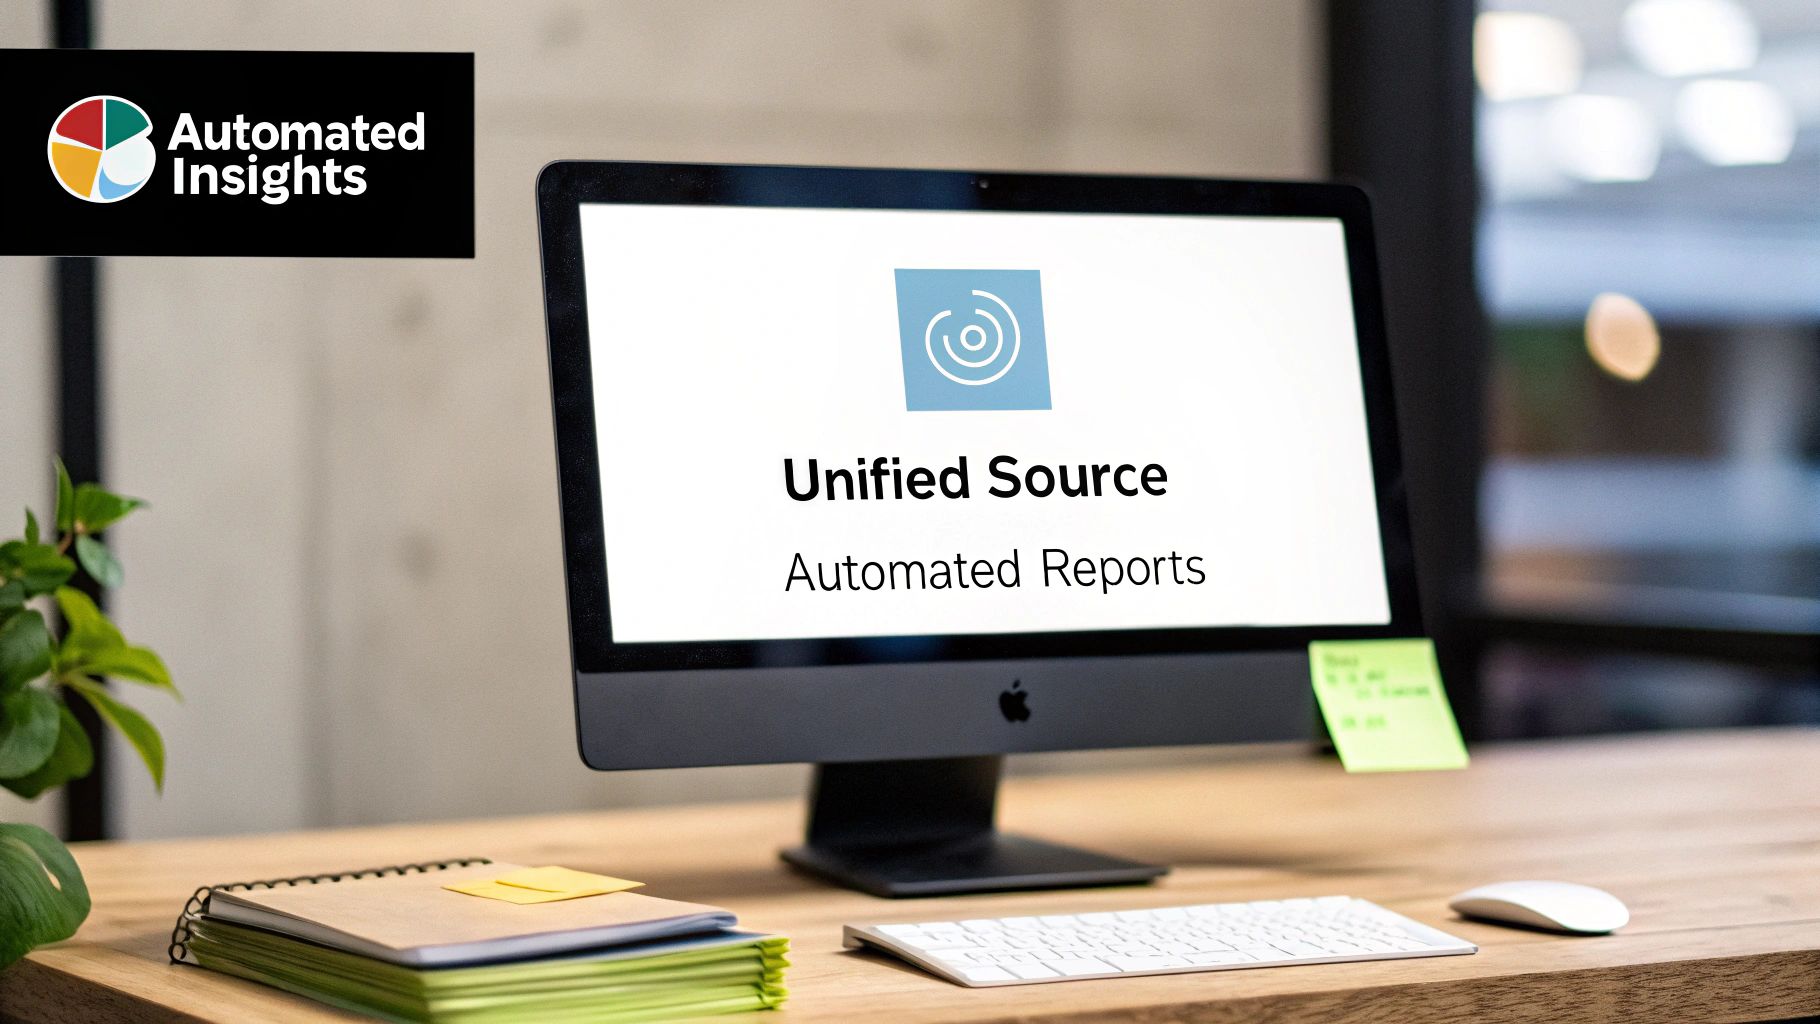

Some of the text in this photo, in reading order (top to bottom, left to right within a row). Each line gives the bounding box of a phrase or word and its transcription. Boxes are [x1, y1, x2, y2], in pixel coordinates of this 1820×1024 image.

[783, 454, 1168, 502] Unified Source
[784, 548, 1207, 595] Automated Reports
